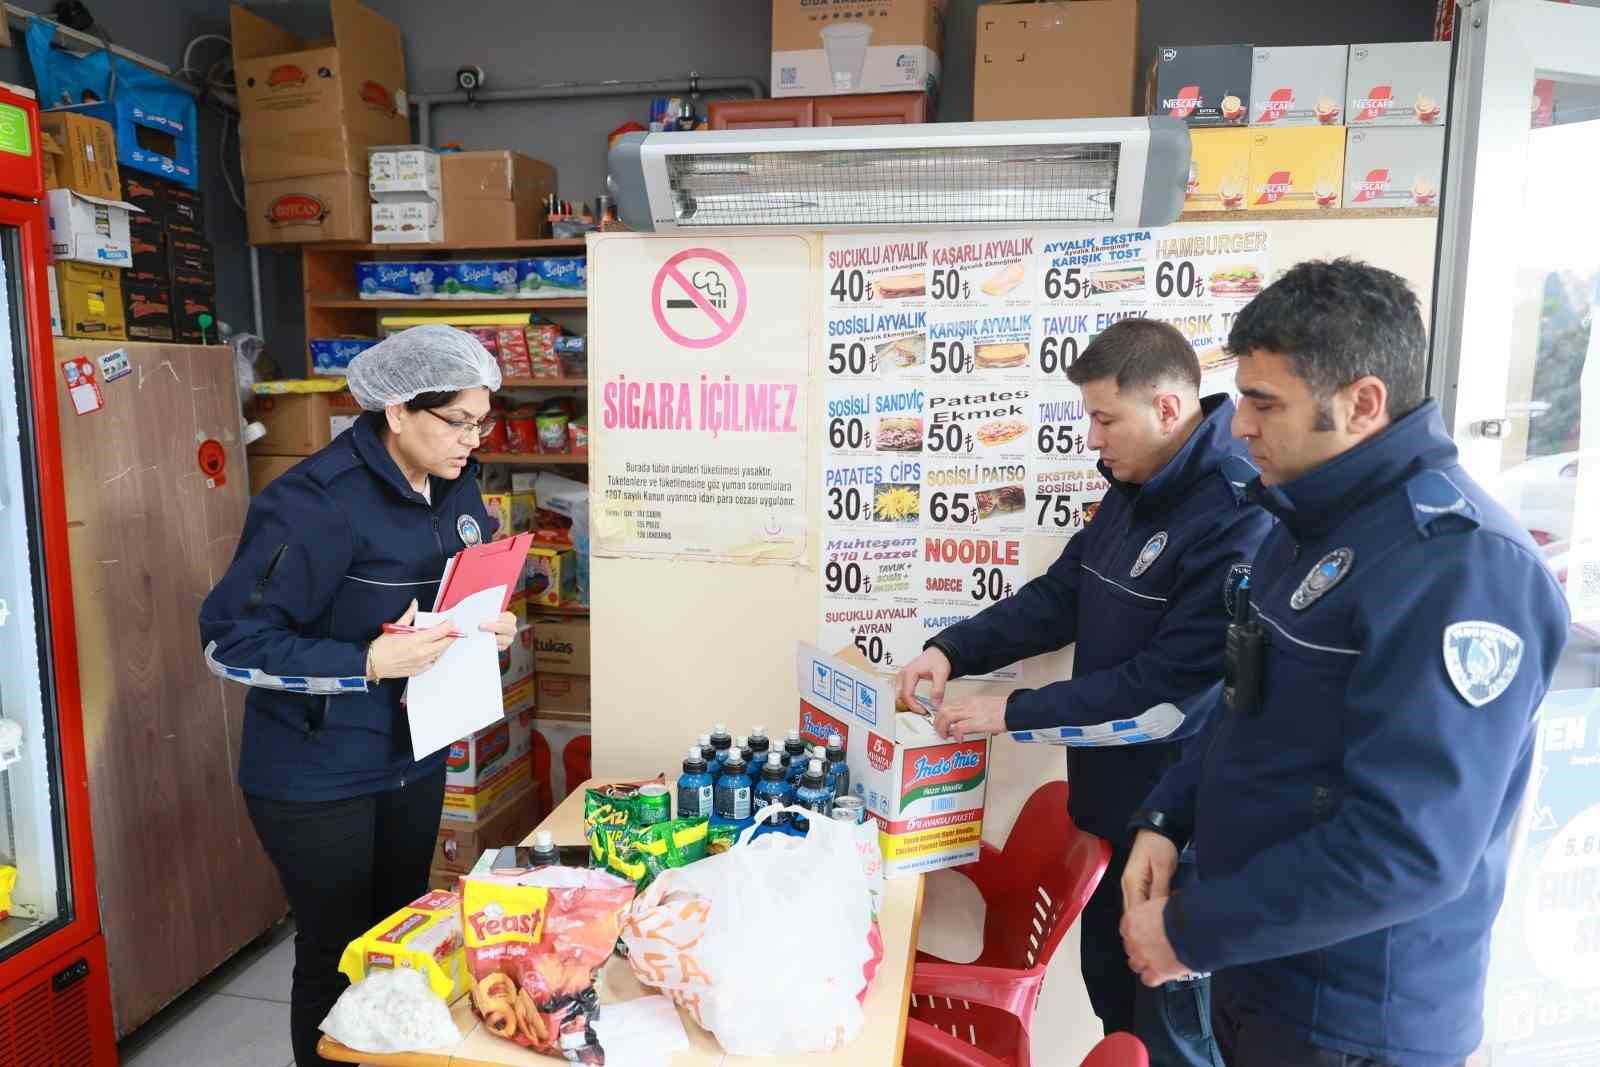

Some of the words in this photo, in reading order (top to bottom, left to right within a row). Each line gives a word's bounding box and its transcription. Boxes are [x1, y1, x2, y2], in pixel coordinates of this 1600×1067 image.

[1044, 238, 1095, 253] AYVALIK
[1102, 231, 1152, 246] EKSTRA
[1155, 231, 1268, 258] HAMBURGER
[829, 246, 880, 269] SUCUKLU
[883, 241, 928, 264] AYVALIK
[932, 242, 982, 268] KAŞARLI
[984, 238, 1033, 260] AYVALIK
[1051, 253, 1101, 267] KARIŞIK
[1109, 247, 1141, 260] TOST
[463, 266, 491, 282] Selpak
[829, 314, 874, 336] SOSİSLİ
[876, 311, 927, 332] AYVALIK
[929, 319, 979, 340] KARIŞIK
[981, 315, 1032, 336] AYVALIK
[1042, 314, 1088, 335] TAVUK
[603, 374, 693, 432] SİGARA
[700, 375, 798, 438] İÇİLMEZ
[828, 393, 870, 417] SOSİSLİ
[875, 388, 925, 413] SANDVİÇ
[929, 390, 1029, 409] Patates
[933, 404, 1024, 424] Ekmek
[1039, 400, 1084, 422] TAVUKLU
[625, 462, 650, 473] Burada
[671, 463, 699, 475] ürünleri
[827, 466, 882, 486] PATATES
[890, 460, 921, 482] CİPS
[928, 464, 978, 486] SOSİSLİ
[982, 465, 1025, 484] PATSO
[1037, 470, 1084, 482] EKSTRA
[649, 479, 658, 487] ve
[707, 479, 720, 491] göz
[721, 481, 746, 492] yuman
[747, 480, 792, 492] sorumlulara
[1037, 482, 1083, 494] SOSİSLİ
[623, 490, 642, 502] sayılı
[643, 492, 665, 501] Kanun
[666, 493, 697, 504] uyarınca
[717, 496, 733, 506] para
[735, 495, 758, 505] cezası
[827, 537, 917, 551] Muhteşem
[862, 548, 918, 560] Lezzet
[925, 538, 1020, 566] NOODLE
[879, 562, 906, 573] TAVUK
[926, 577, 963, 593] SADECE
[825, 608, 873, 623] SUCUKLU
[875, 607, 918, 620] AYVALIK
[857, 623, 892, 635] AYRAN
[467, 908, 542, 940] Feast
